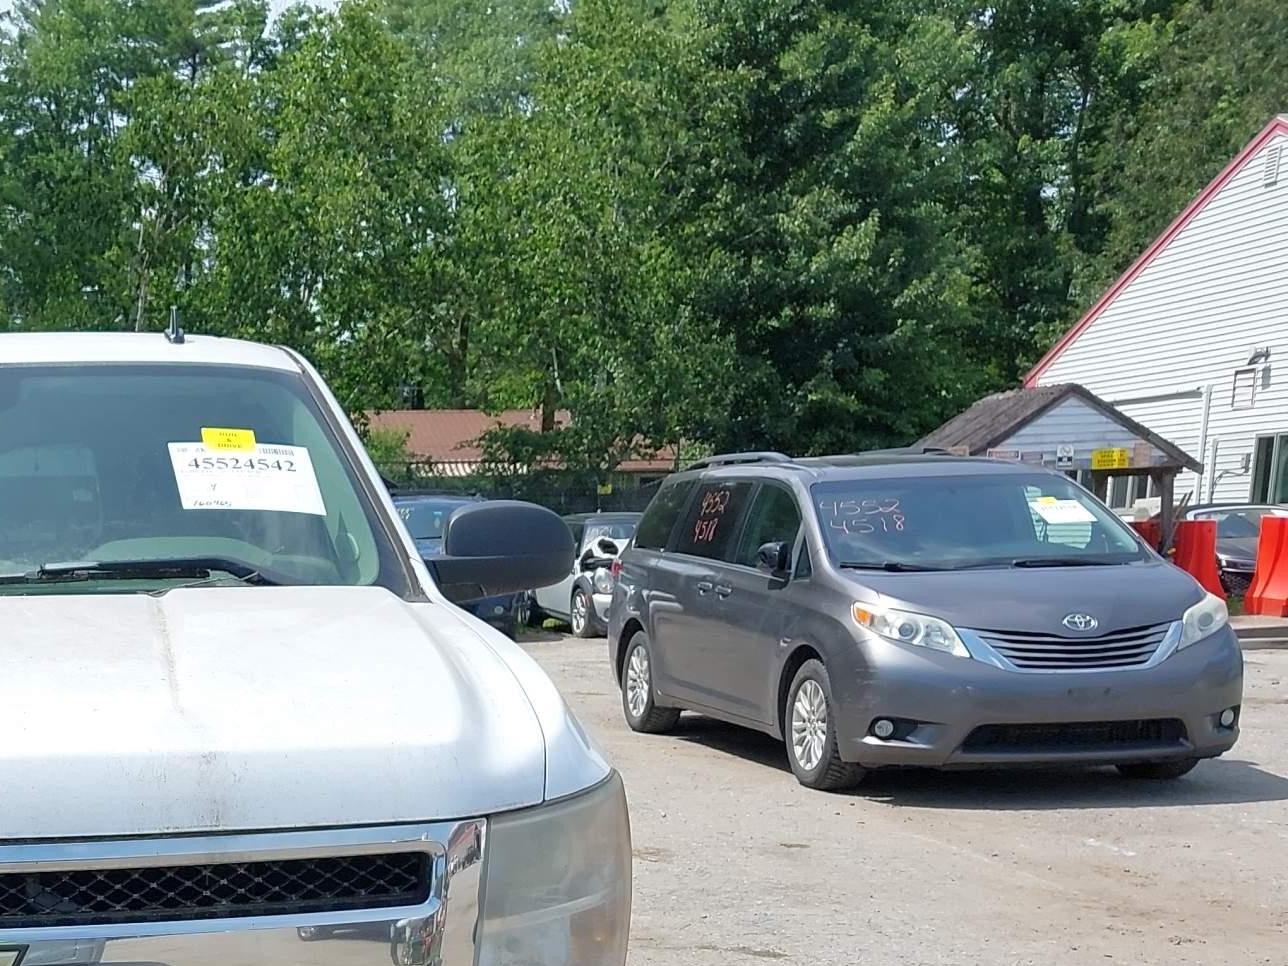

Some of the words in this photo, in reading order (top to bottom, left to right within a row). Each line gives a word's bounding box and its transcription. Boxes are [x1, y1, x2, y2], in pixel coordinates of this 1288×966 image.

[187, 457, 298, 473] 45524542
[819, 499, 901, 516] 4552
[830, 514, 905, 535] 4518
